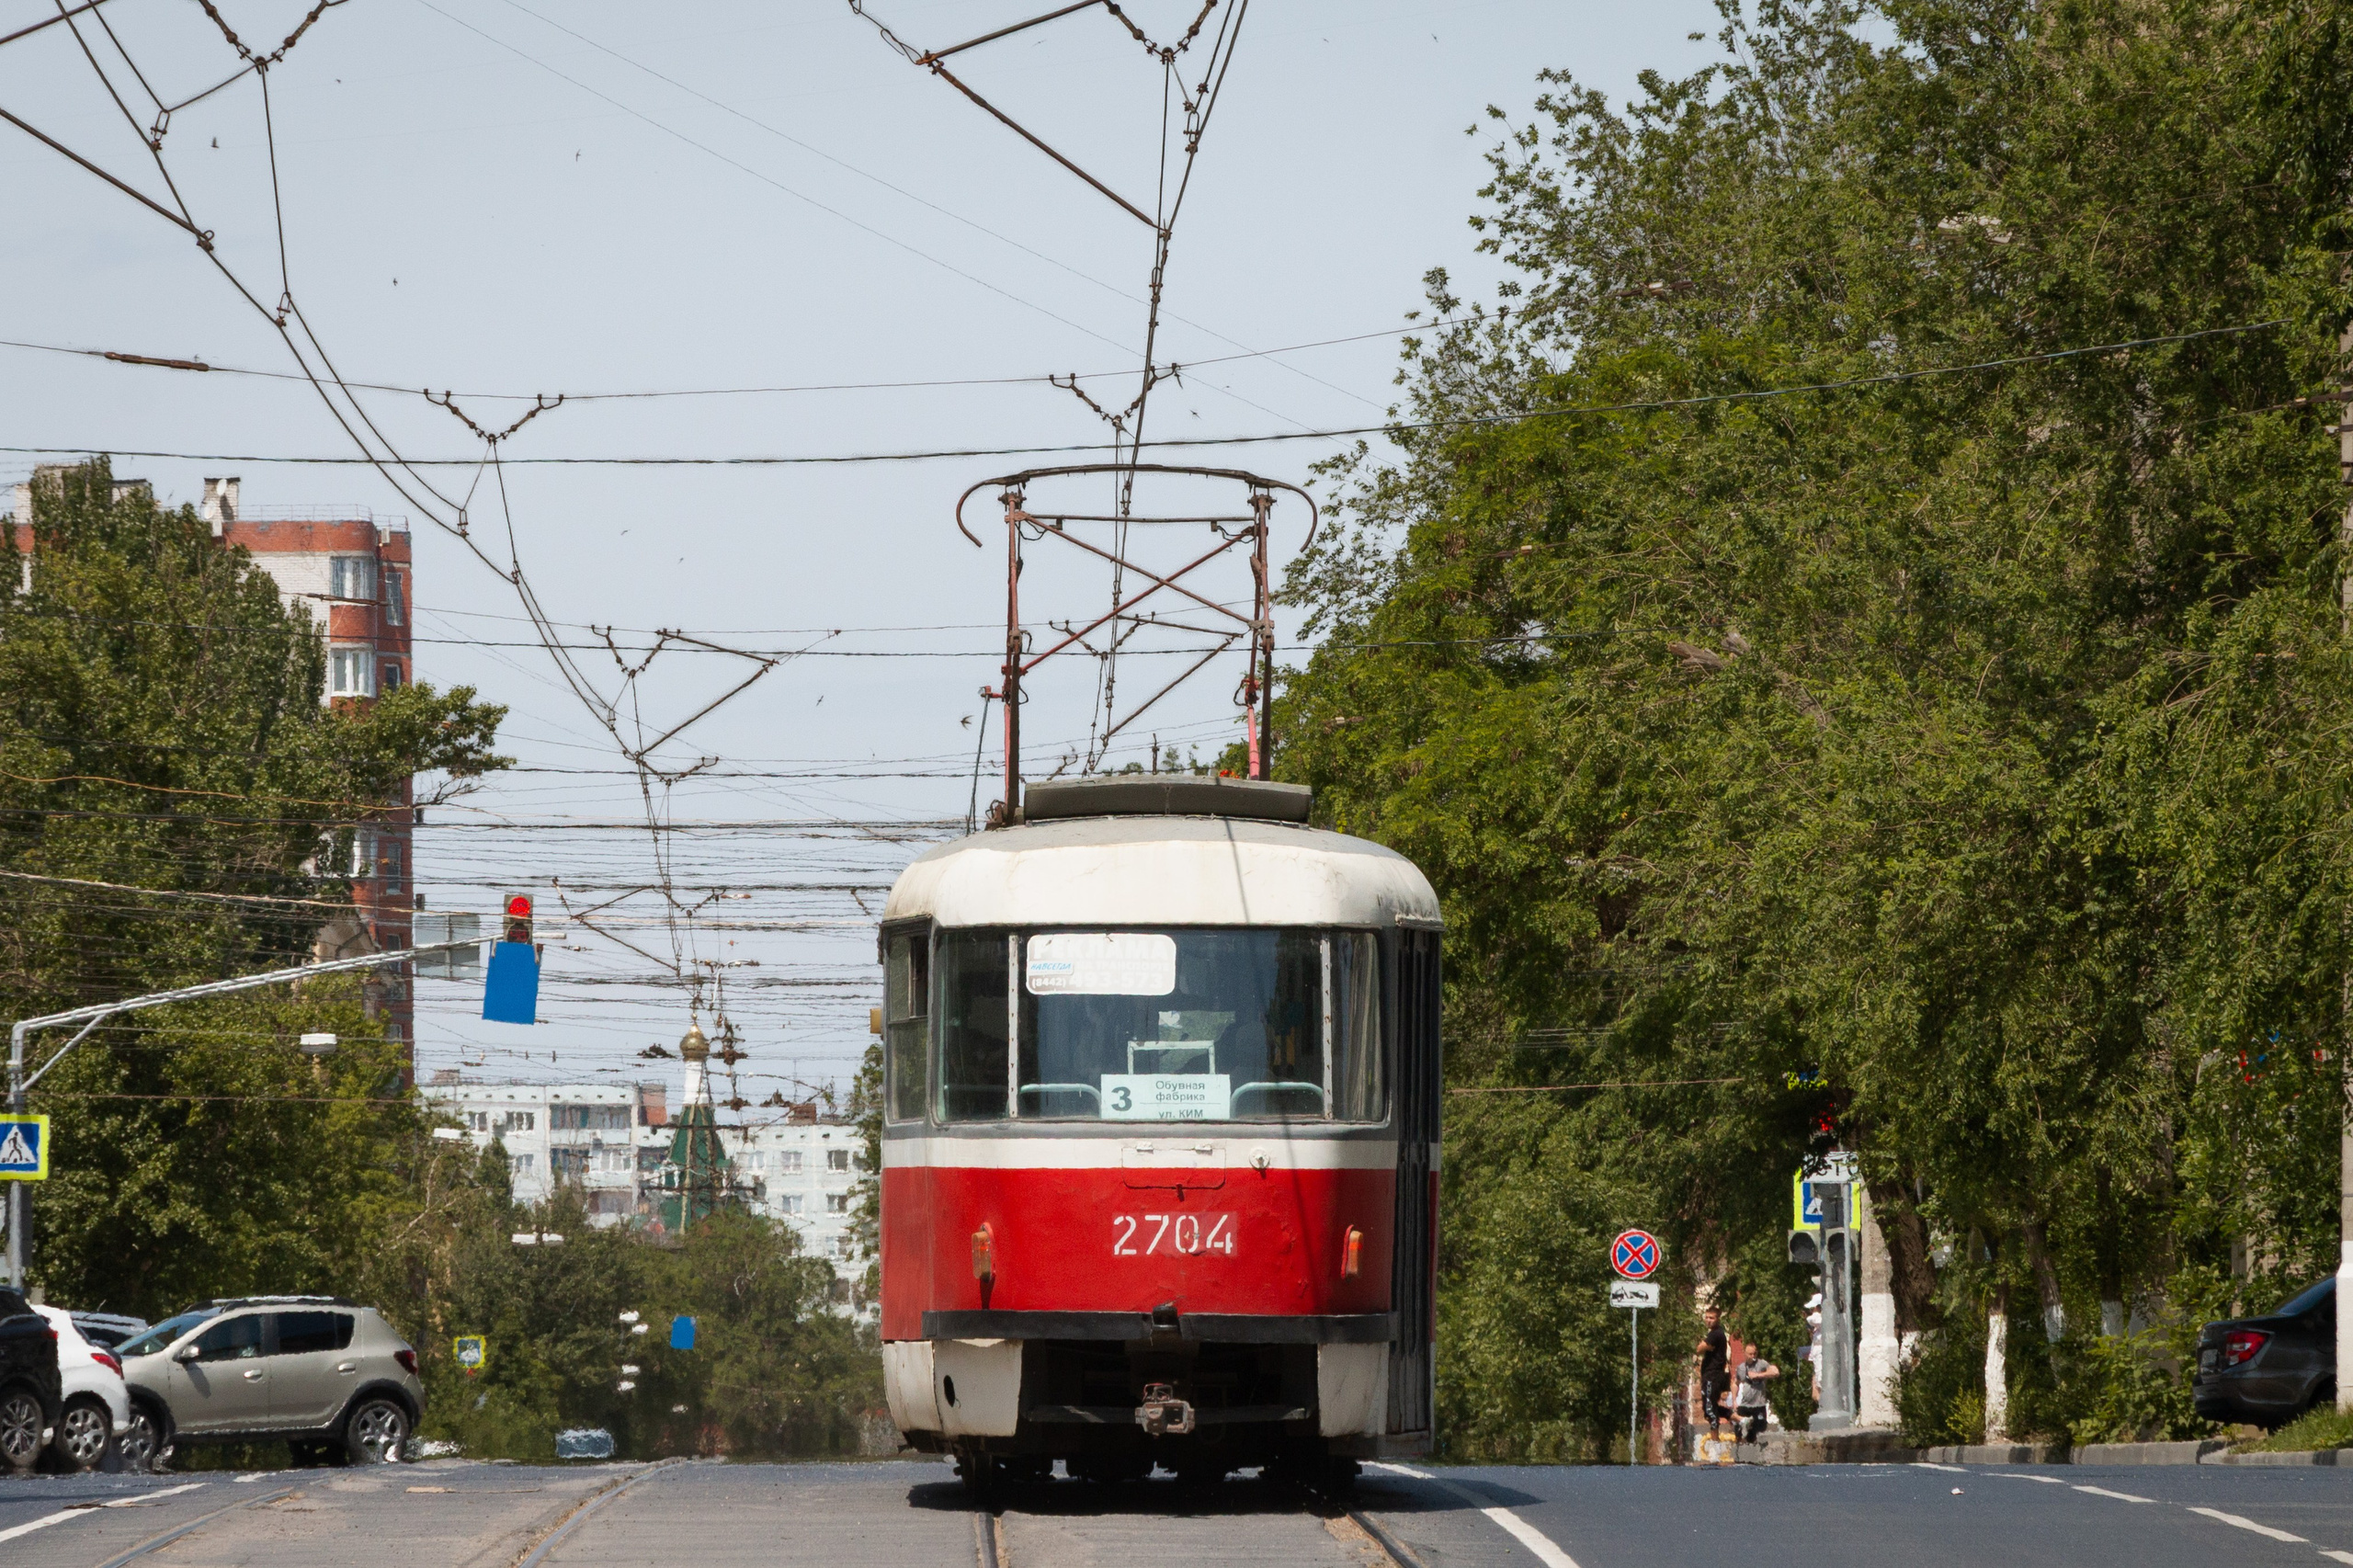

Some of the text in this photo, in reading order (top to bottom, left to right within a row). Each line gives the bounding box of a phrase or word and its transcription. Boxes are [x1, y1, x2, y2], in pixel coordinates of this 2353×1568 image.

[1033, 938, 1168, 960] РЕКЛАМА
[1030, 962, 1071, 971] НАВСЕГДА
[1031, 971, 1164, 990] (8442) 493-573
[1155, 1081, 1205, 1091] Обувная
[1110, 1085, 1132, 1111] 3
[1155, 1092, 1205, 1103] фабрика
[1158, 1109, 1203, 1119] ул. КИМ
[1113, 1214, 1233, 1256] 2704
